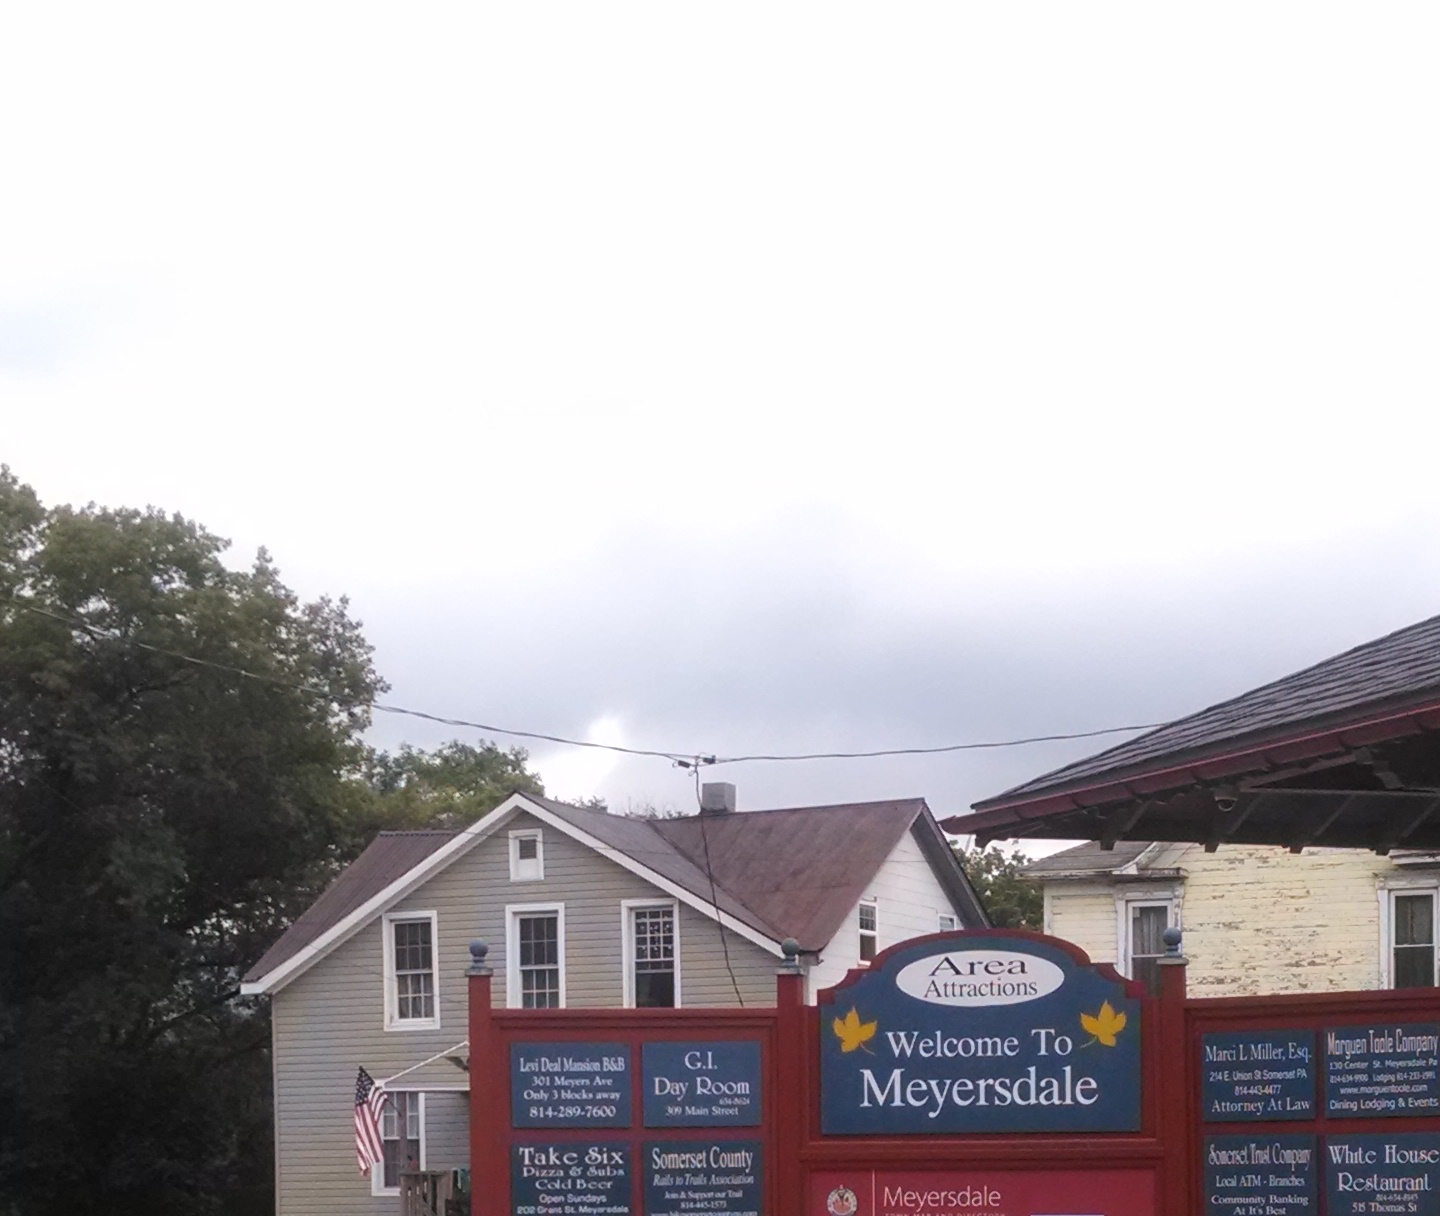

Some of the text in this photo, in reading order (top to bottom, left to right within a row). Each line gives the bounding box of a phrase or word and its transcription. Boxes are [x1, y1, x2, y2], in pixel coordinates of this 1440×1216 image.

[929, 957, 1028, 977] Area
[924, 979, 1038, 999] Attractions
[885, 1028, 1073, 1058] Welcome To
[1328, 1029, 1438, 1059] Morguen Toole Company
[1205, 1042, 1311, 1063] Marci L Miller, Esq.
[520, 1057, 625, 1072] Levi Deal Mansion B&B
[685, 1051, 718, 1069] G.I.
[1385, 1059, 1426, 1068] Meyersdale
[1429, 1058, 1437, 1066] Pa
[1233, 1071, 1252, 1080] Union
[1263, 1070, 1295, 1080] Somerset
[1297, 1068, 1307, 1079] PA
[532, 1076, 613, 1087] 301 Meyers Ave
[524, 1090, 620, 1100] Only 3 blocks away
[654, 1077, 750, 1101] Day Room
[860, 1066, 1099, 1118] Meyersdale
[685, 1107, 708, 1115] Main
[712, 1106, 738, 1115] Street
[1212, 1097, 1310, 1115] Attorney At Law
[1330, 1098, 1439, 1111] Dining Lodging & Events
[530, 1106, 616, 1118] 814-289-7600
[519, 1146, 624, 1165] Take Six
[652, 1146, 753, 1173] Somerset County
[1209, 1143, 1311, 1171] Somerset Trust Company
[1328, 1144, 1439, 1164] White House
[523, 1166, 625, 1177] Pizza & Subs
[536, 1179, 613, 1190] Cold Beer
[653, 1174, 754, 1186] Rails to Trails Association
[1216, 1175, 1305, 1187] Local ATM Branches
[1337, 1172, 1431, 1191] Restaurant
[539, 1193, 607, 1204] Open Sundays
[688, 1191, 714, 1200] Support
[727, 1190, 743, 1198] Trail
[884, 1186, 1001, 1212] Meyersdale
[1211, 1194, 1309, 1206] Community Banking
[537, 1206, 562, 1214] Grant
[579, 1205, 629, 1214] Meyersdale
[1234, 1206, 1286, 1215] At It's Best
[1368, 1202, 1405, 1212] Thomas
[1408, 1202, 1417, 1212] St
